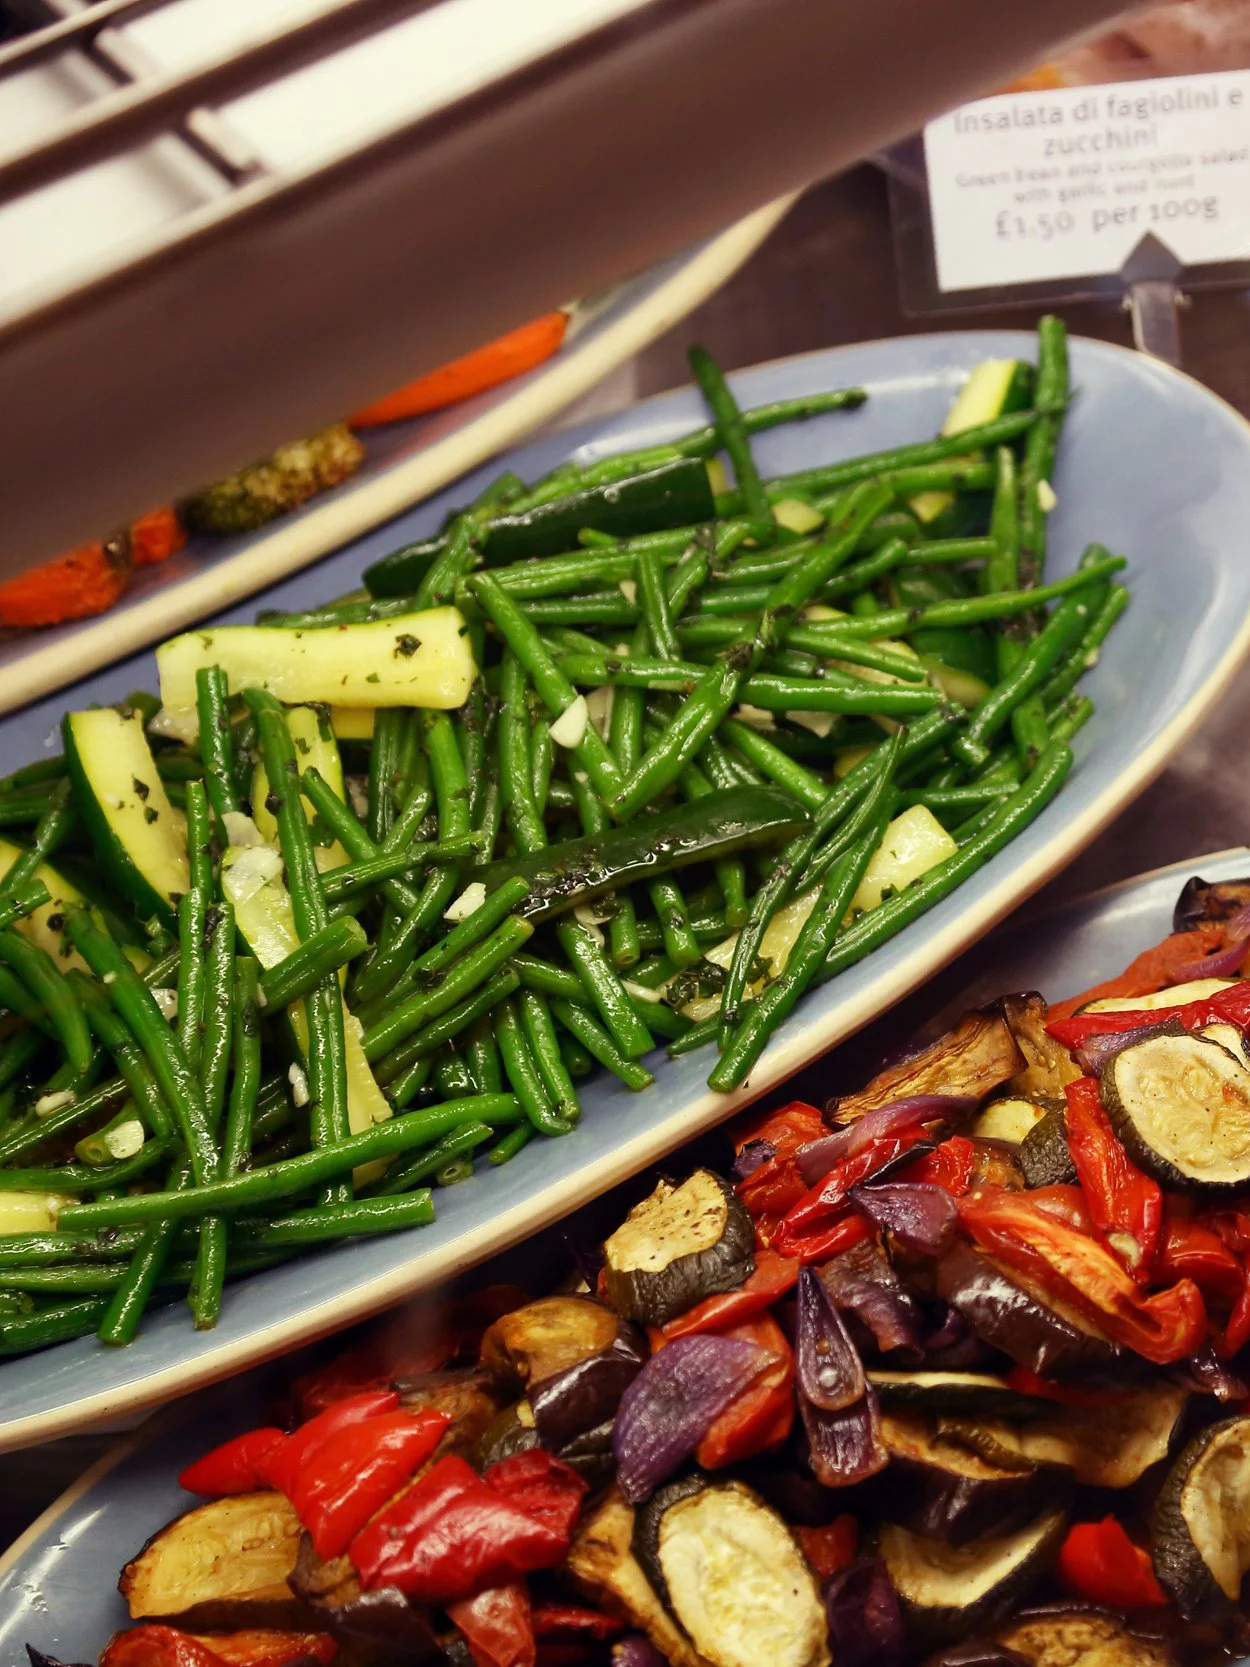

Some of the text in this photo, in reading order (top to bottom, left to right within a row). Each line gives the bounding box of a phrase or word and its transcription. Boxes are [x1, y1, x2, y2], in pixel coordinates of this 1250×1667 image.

[953, 85, 1244, 135] Insalata di fagiolini e
[1043, 125, 1158, 158] zucchini
[955, 167, 1012, 189] Green
[1067, 157, 1100, 179] and
[1199, 146, 1249, 167] salad
[1013, 186, 1052, 204] with
[1113, 175, 1149, 197] and
[995, 194, 1219, 241] £1.50 per 100g
